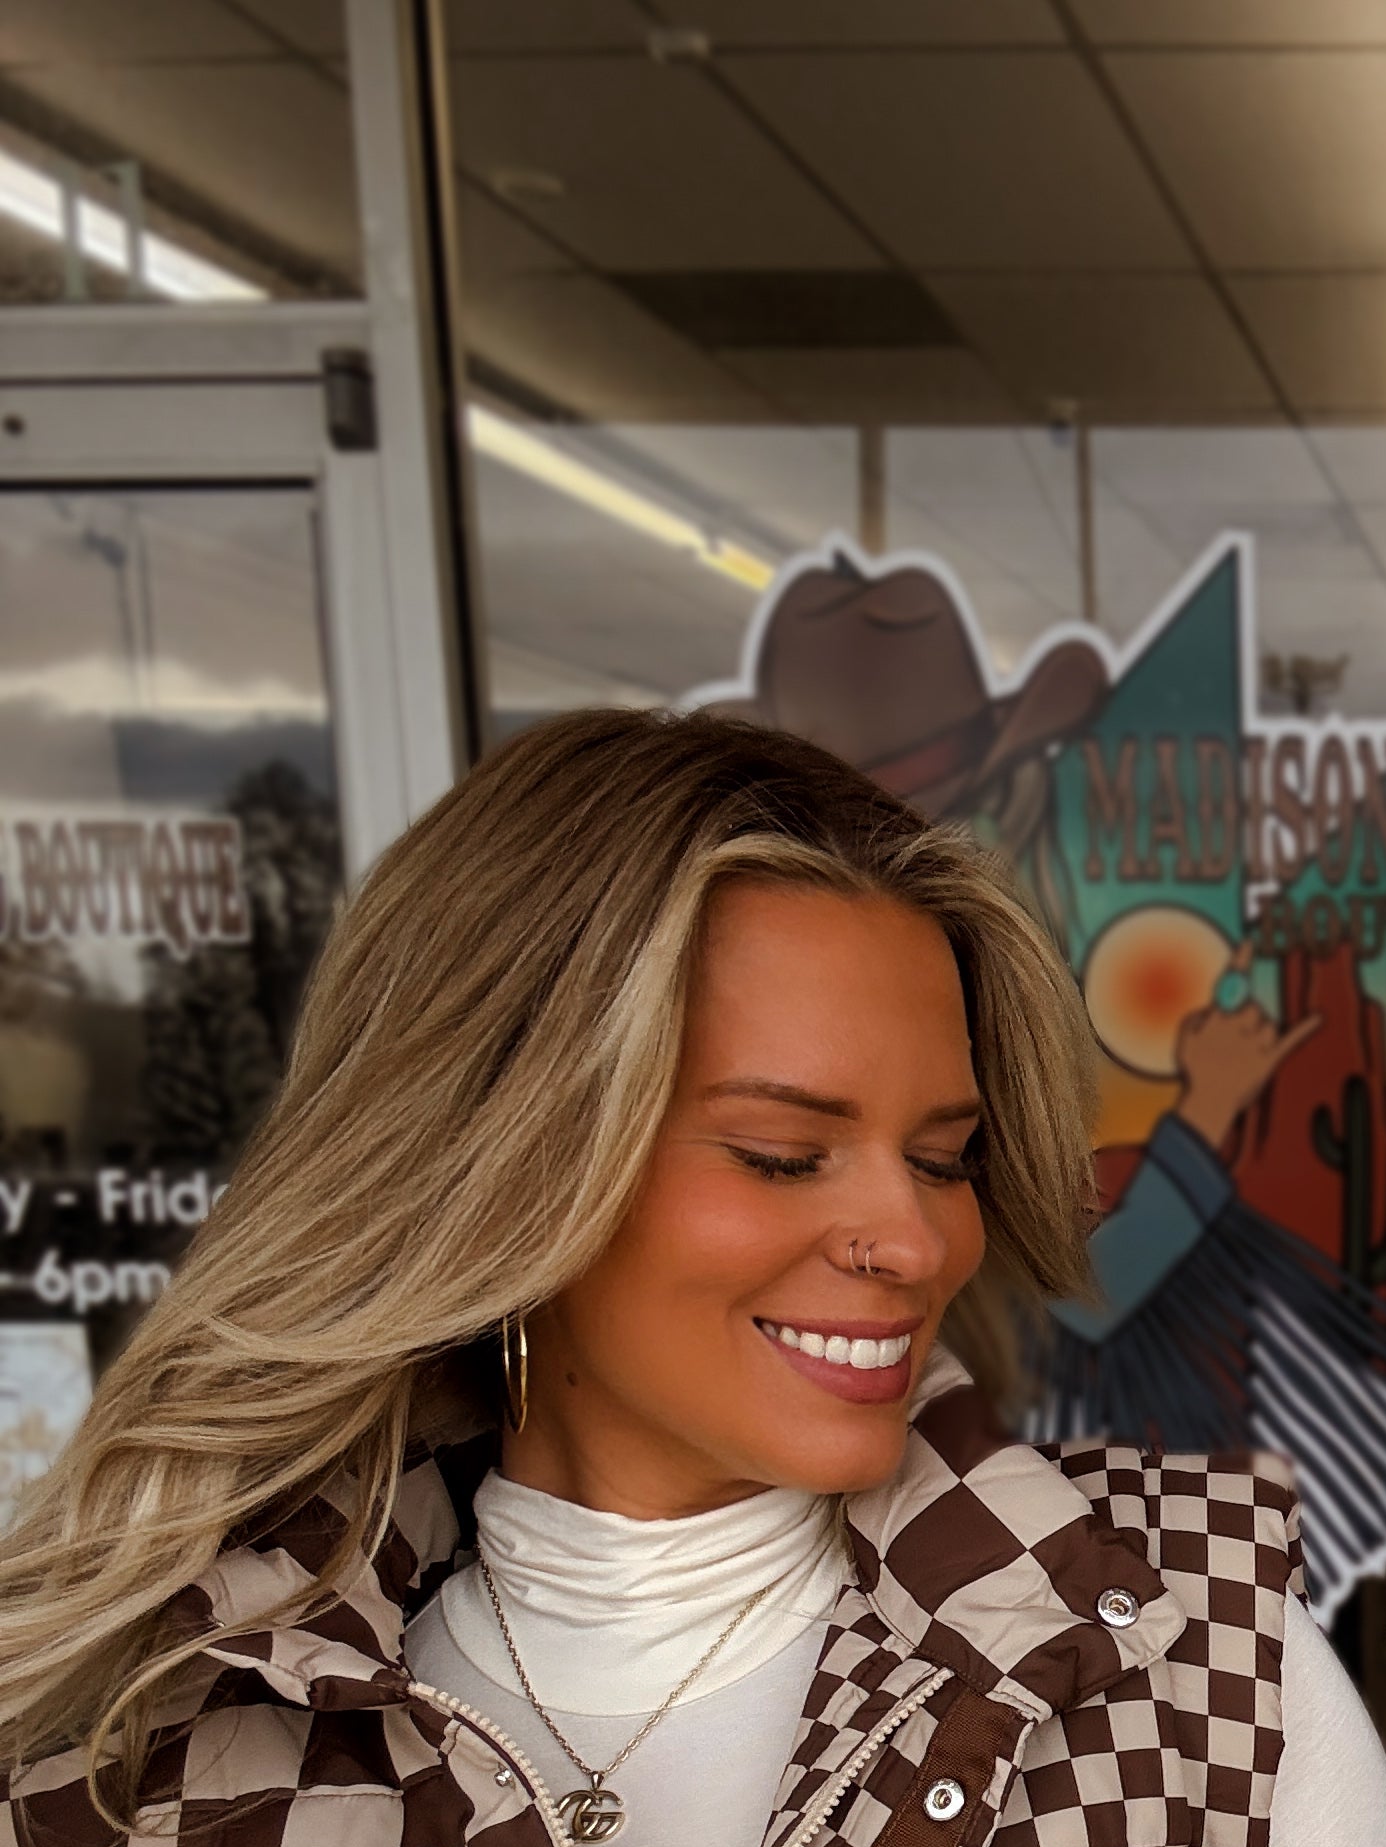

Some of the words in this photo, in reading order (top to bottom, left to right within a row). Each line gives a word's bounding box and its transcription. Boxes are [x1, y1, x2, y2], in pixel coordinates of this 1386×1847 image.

[15, 819, 242, 950] BOUTIQUE
[97, 1168, 230, 1225] Frid
[33, 1248, 171, 1314] 6pm
